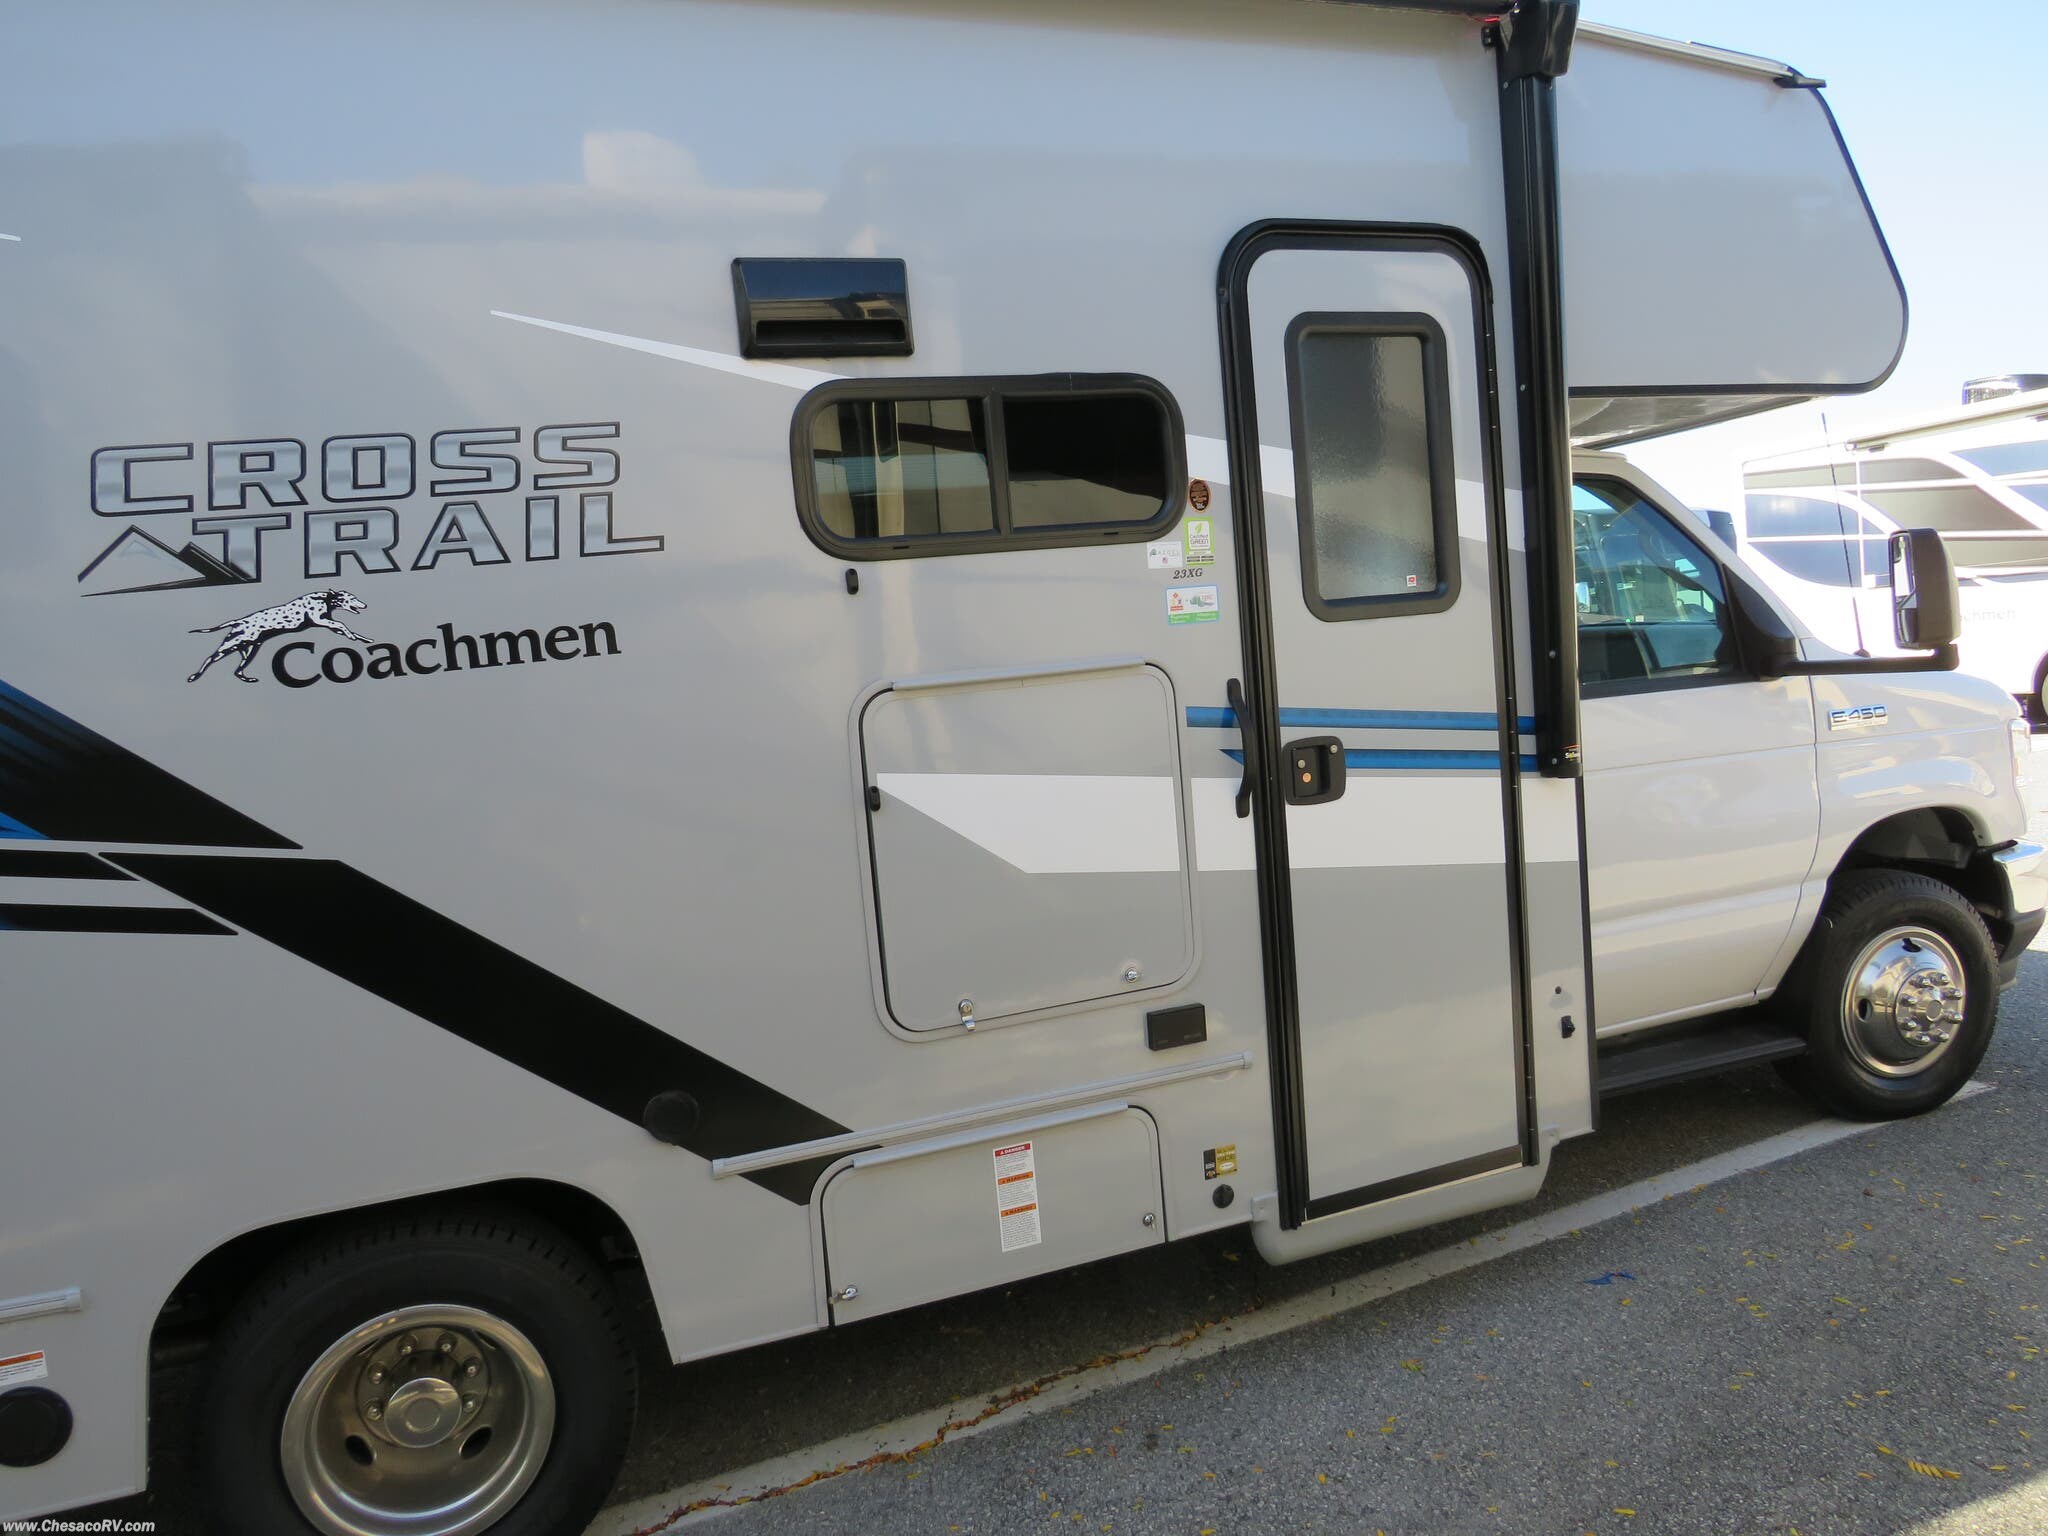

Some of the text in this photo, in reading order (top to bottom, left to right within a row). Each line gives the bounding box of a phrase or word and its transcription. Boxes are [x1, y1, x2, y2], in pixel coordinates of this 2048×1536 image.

[90, 421, 621, 517] CROSS
[192, 491, 665, 584] TRAIL
[1173, 567, 1203, 580] 23XG
[271, 621, 622, 689] Coachmen
